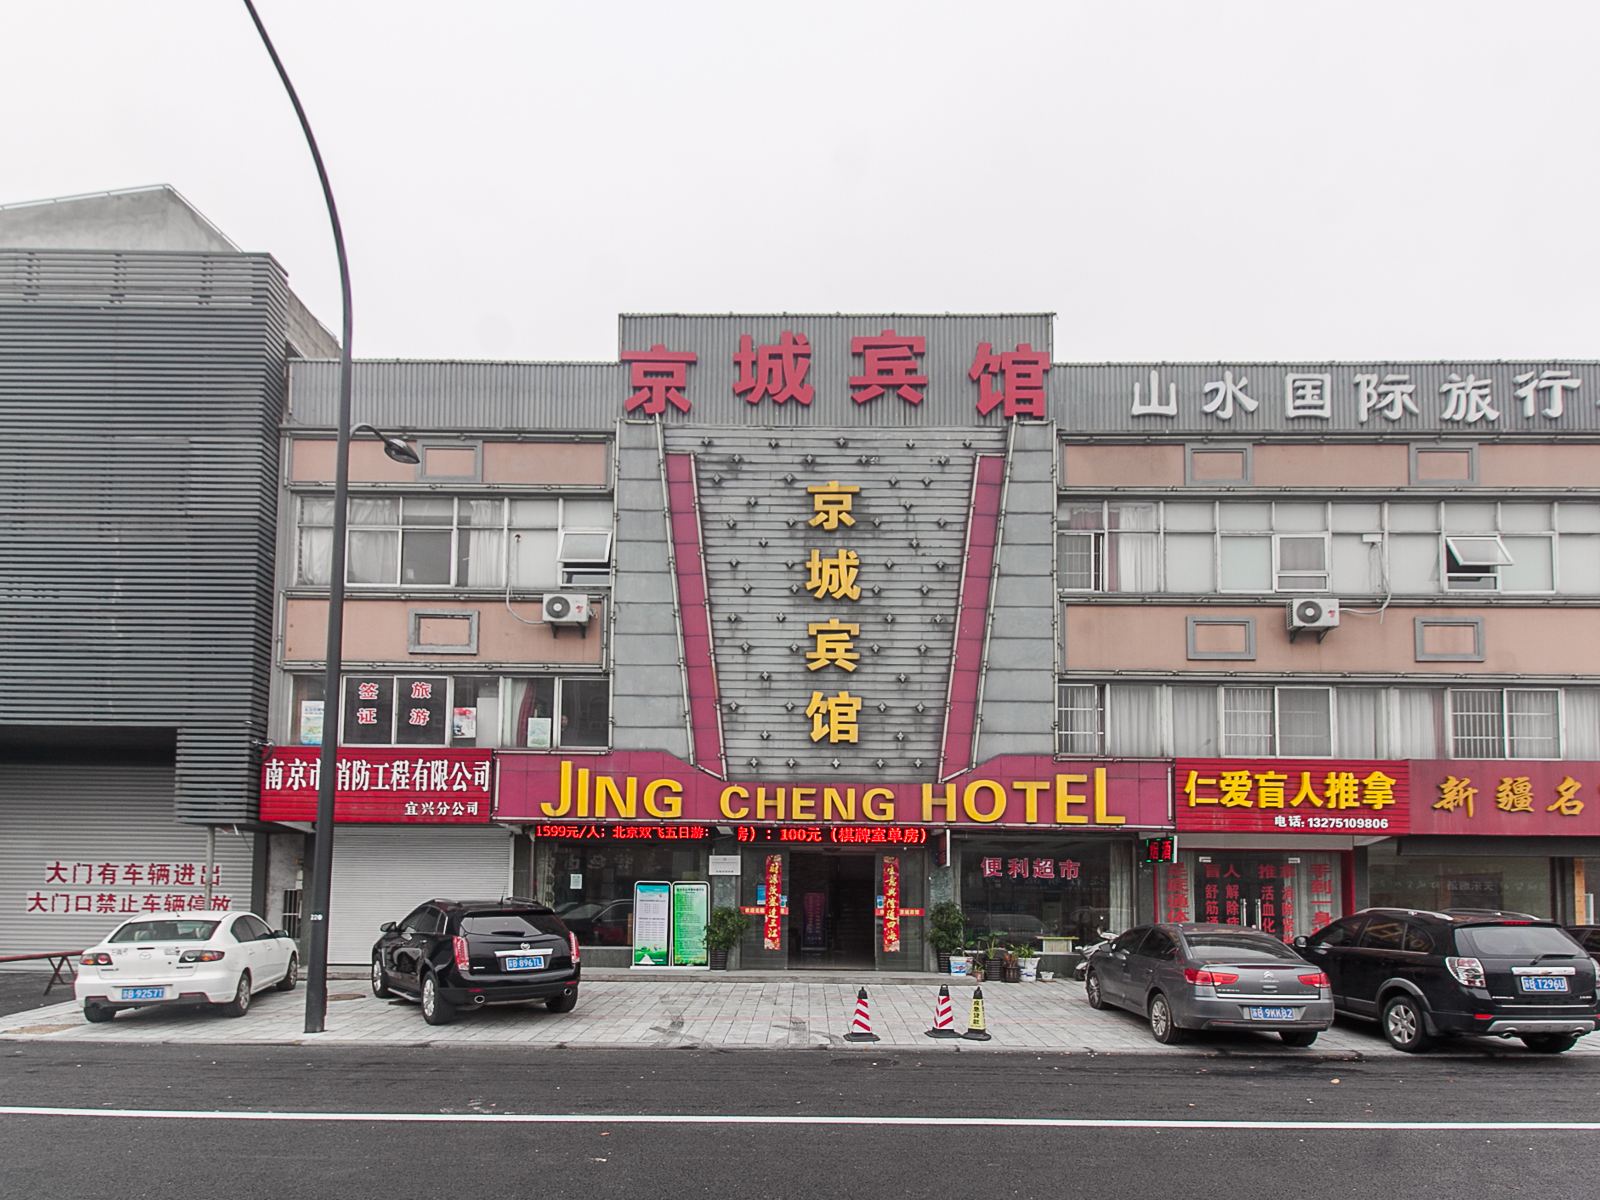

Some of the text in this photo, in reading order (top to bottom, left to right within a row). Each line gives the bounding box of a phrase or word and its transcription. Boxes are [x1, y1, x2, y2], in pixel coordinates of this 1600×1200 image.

[621, 329, 1050, 418] 京城宾馆
[1131, 370, 1600, 423] 山水国际旅行
[805, 481, 862, 743] 京城宾馆
[357, 682, 379, 725] 签证
[409, 682, 432, 726] 旅游
[404, 801, 479, 816] 宜兴分公司
[540, 760, 1126, 824] JING CHENG HOTEL
[1184, 770, 1397, 809] 仁爱盲人推拿
[1433, 775, 1600, 818] 新疆名
[46, 861, 220, 886] 大门有车辆进出
[980, 857, 1081, 880] 便利超市
